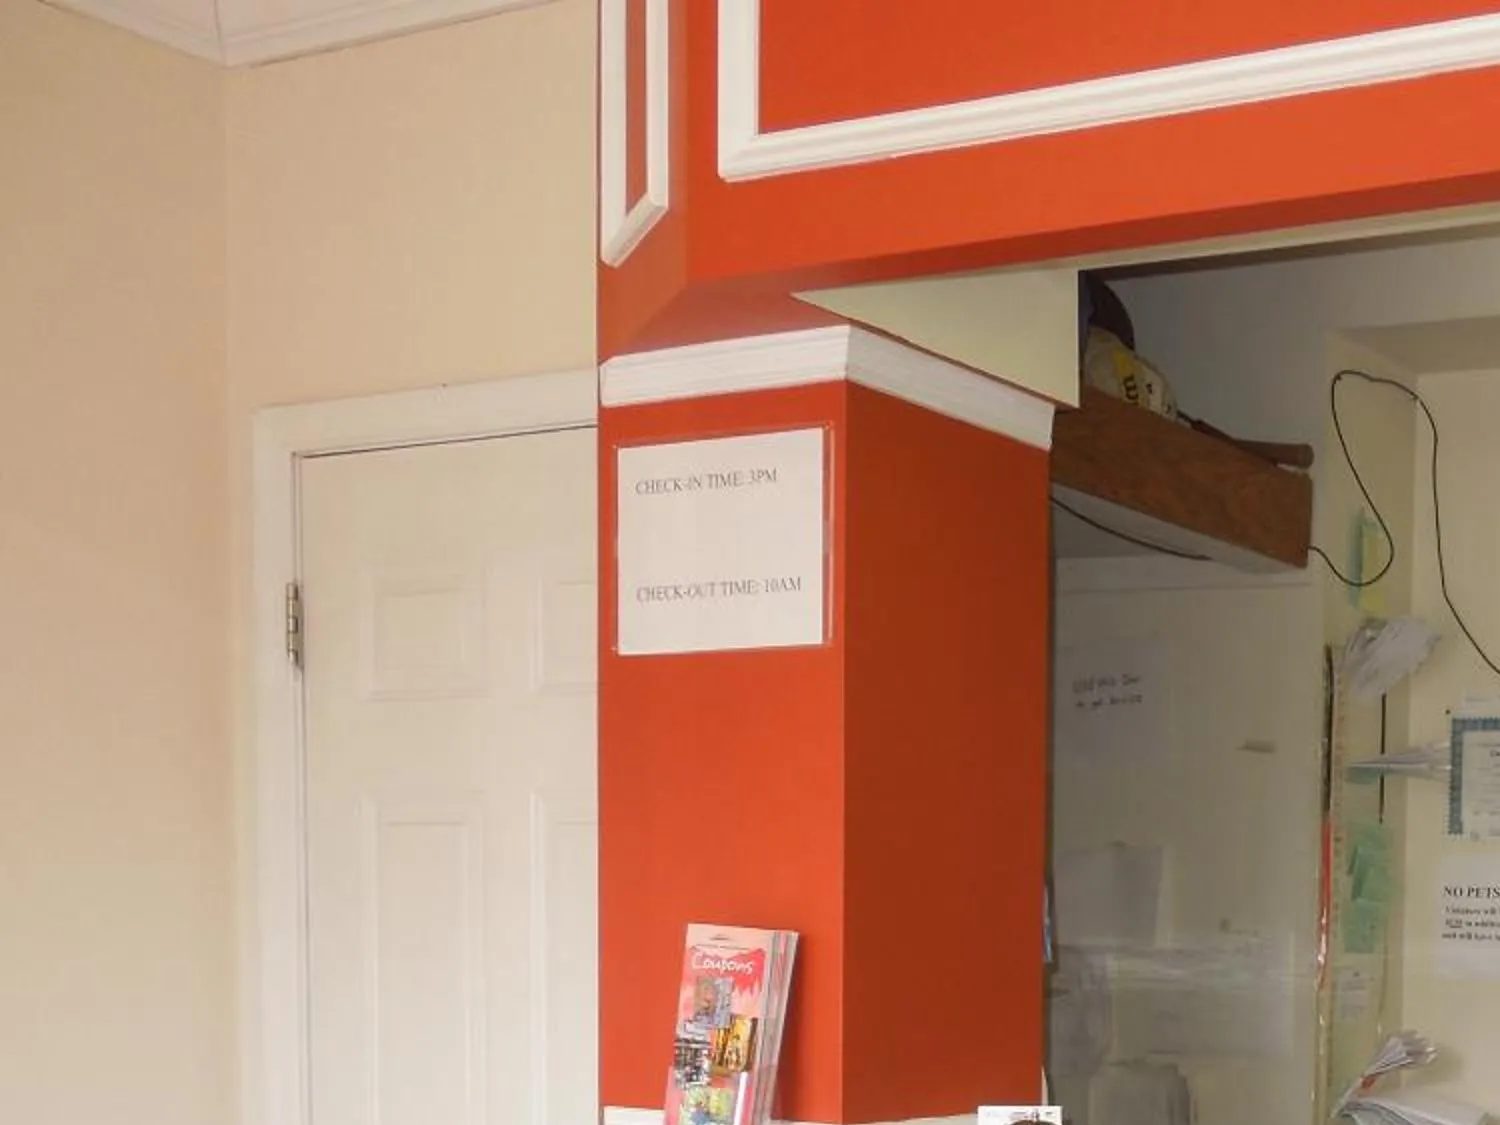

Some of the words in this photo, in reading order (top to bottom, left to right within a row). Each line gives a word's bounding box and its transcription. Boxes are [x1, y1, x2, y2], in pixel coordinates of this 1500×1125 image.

[635, 475, 702, 495] CHECK-IN
[747, 467, 778, 485] 3PM
[636, 581, 716, 604] CHECK-OUT
[764, 576, 802, 594] 10AM
[1444, 886, 1463, 897] NO
[1467, 886, 1500, 899] PETS
[691, 952, 755, 975] Coupons
